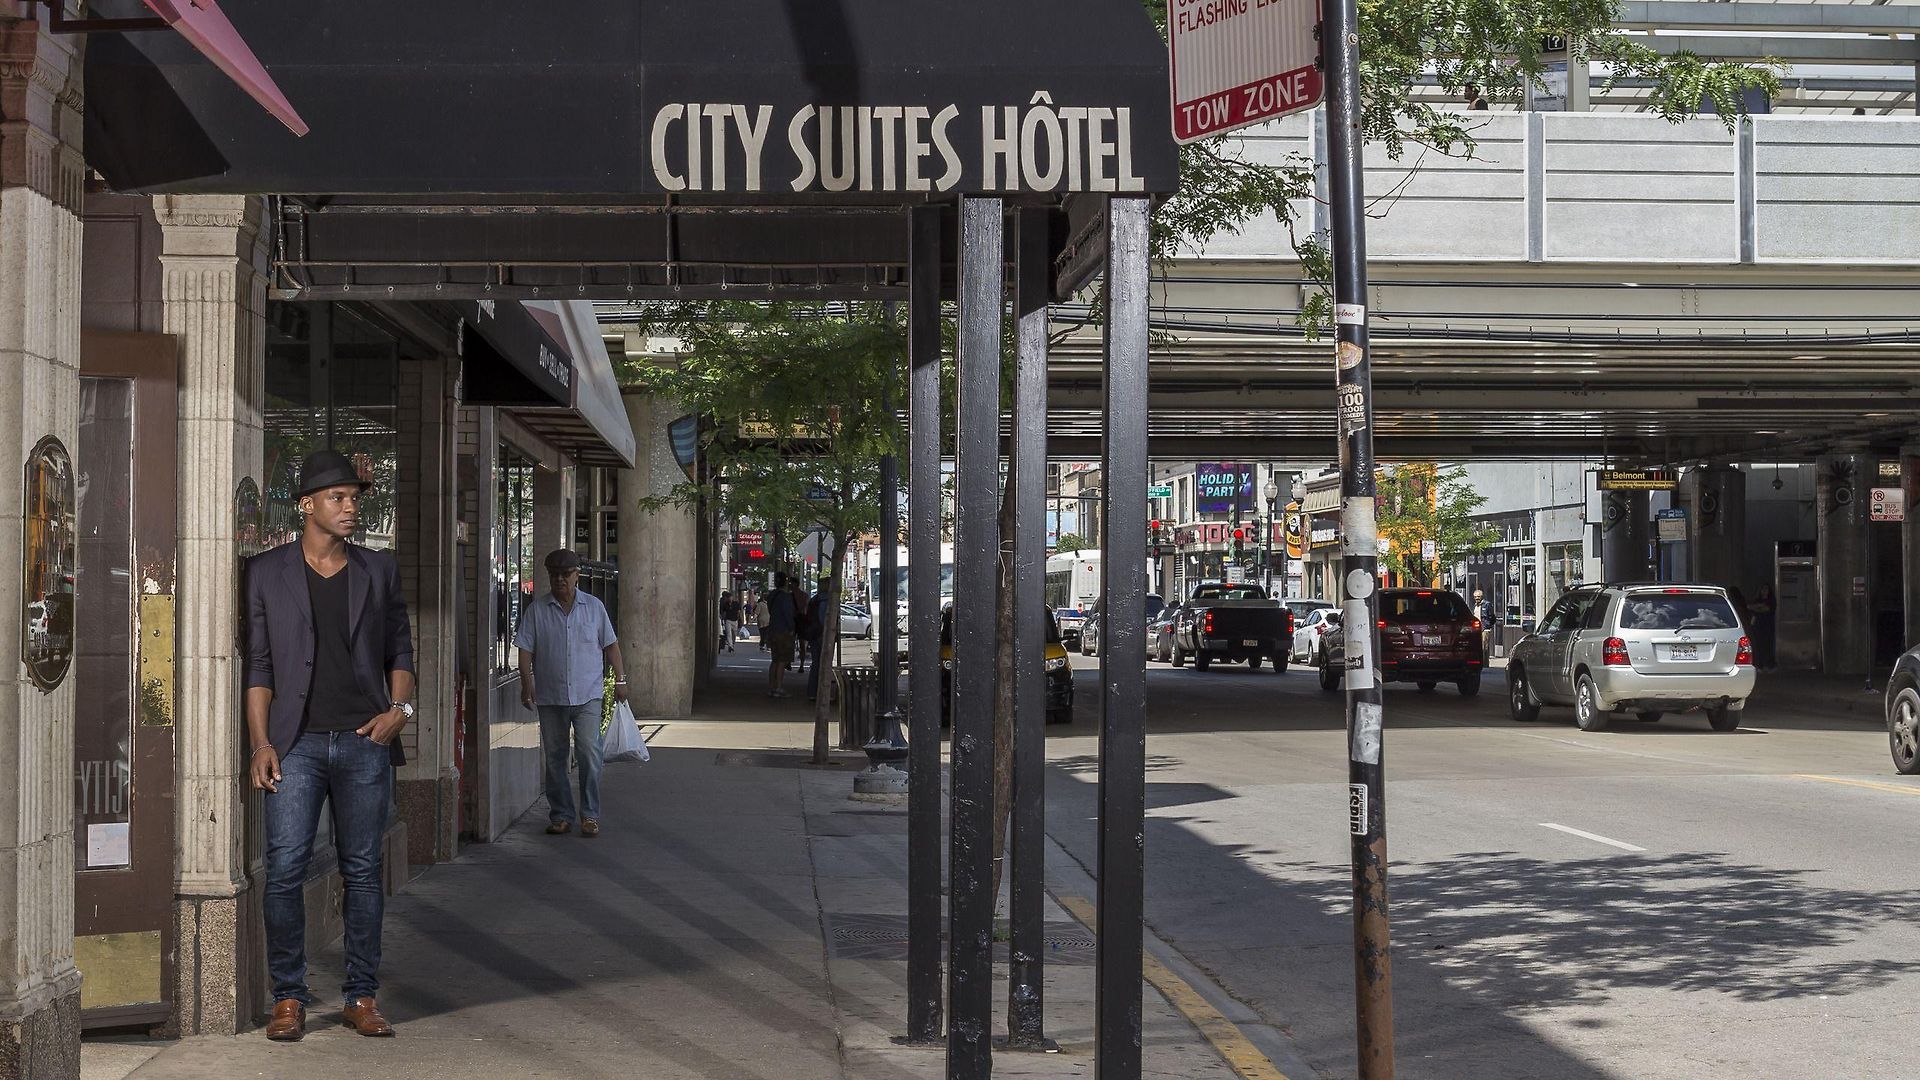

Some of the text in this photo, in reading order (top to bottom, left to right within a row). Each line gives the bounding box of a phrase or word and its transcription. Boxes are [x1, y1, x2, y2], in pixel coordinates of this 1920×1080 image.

[1178, 0, 1248, 35] FLASHING
[1182, 71, 1309, 134] TOW ZONE
[651, 90, 1145, 192] CITY SUITES HÔTEL
[1338, 393, 1365, 408] 100
[1199, 472, 1250, 485] HOLIDY
[1612, 471, 1646, 480] Belmont
